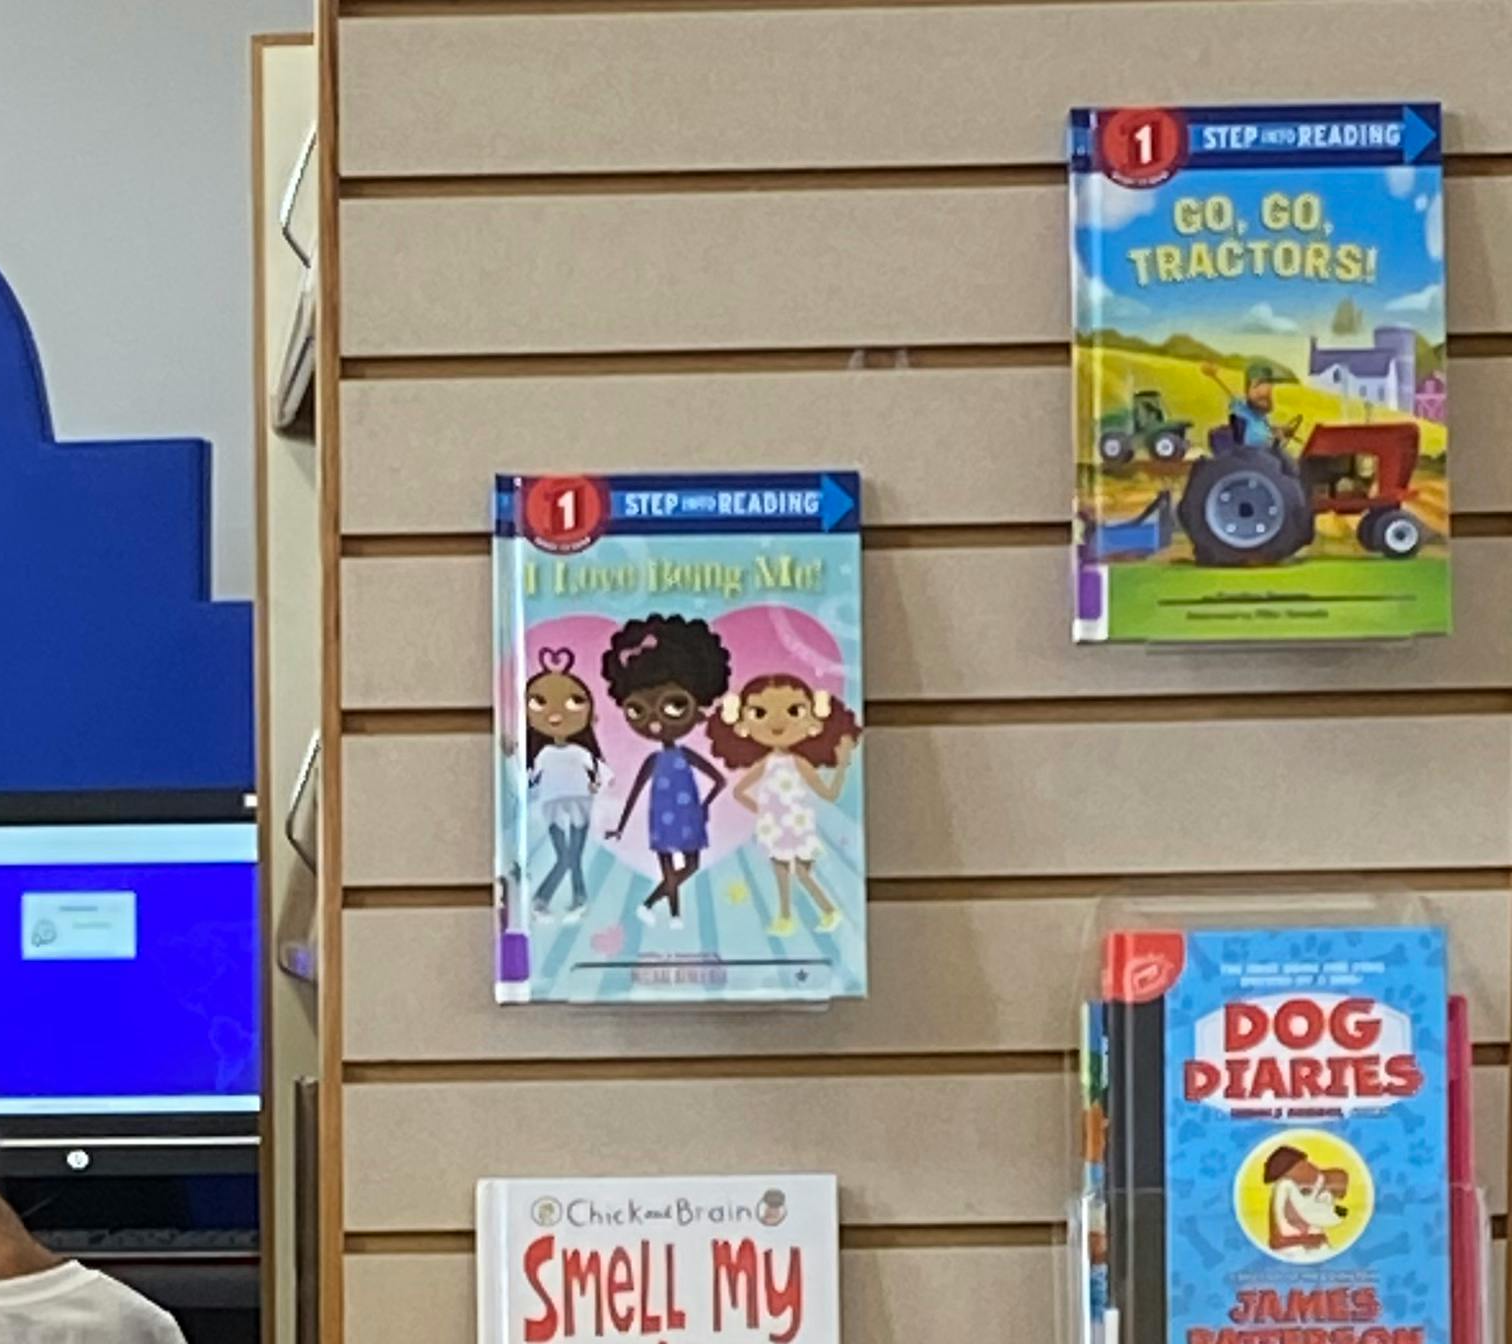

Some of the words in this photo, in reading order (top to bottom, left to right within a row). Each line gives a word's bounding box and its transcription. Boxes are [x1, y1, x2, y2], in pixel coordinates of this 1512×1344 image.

[1134, 123, 1153, 165] 1
[1203, 125, 1258, 149] STEP
[1297, 124, 1402, 148] READING
[1173, 194, 1247, 236] GO,
[1260, 192, 1334, 235] GO,
[1127, 239, 1380, 287] TRACTORS!
[555, 489, 576, 531] 1
[625, 492, 679, 516] STEP
[718, 491, 820, 515] READING
[1224, 997, 1382, 1053] DOG
[1183, 1054, 1425, 1103] DIARIES
[566, 1197, 640, 1228] Chick
[675, 1196, 753, 1227] Brain
[1228, 1286, 1382, 1325] JAMES
